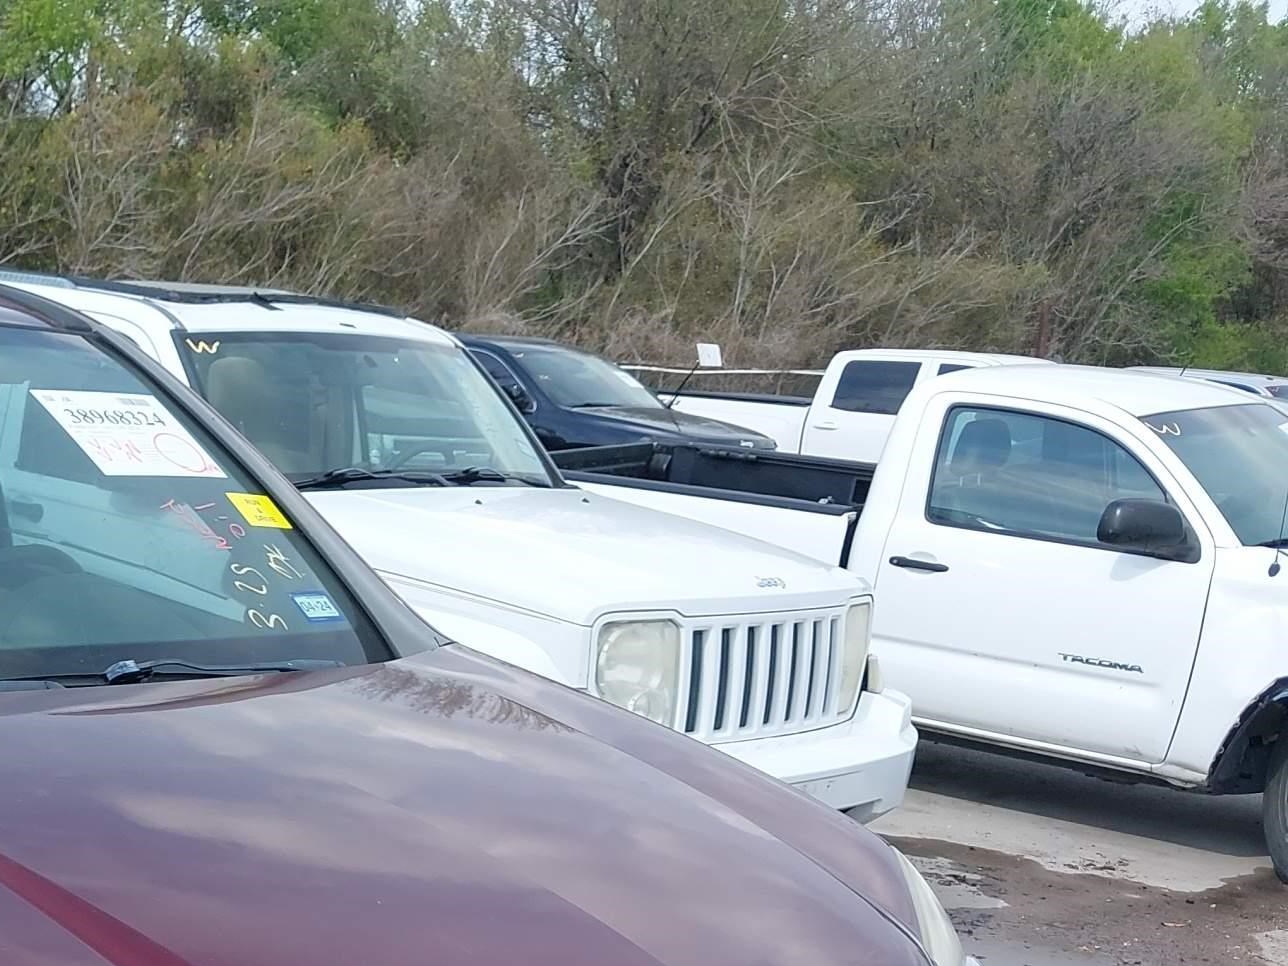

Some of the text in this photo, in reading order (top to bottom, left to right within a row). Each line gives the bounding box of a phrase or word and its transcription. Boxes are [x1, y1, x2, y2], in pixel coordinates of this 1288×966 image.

[185, 338, 221, 354] W
[63, 407, 166, 427] 38968324
[1057, 652, 1145, 674] TACOMA
